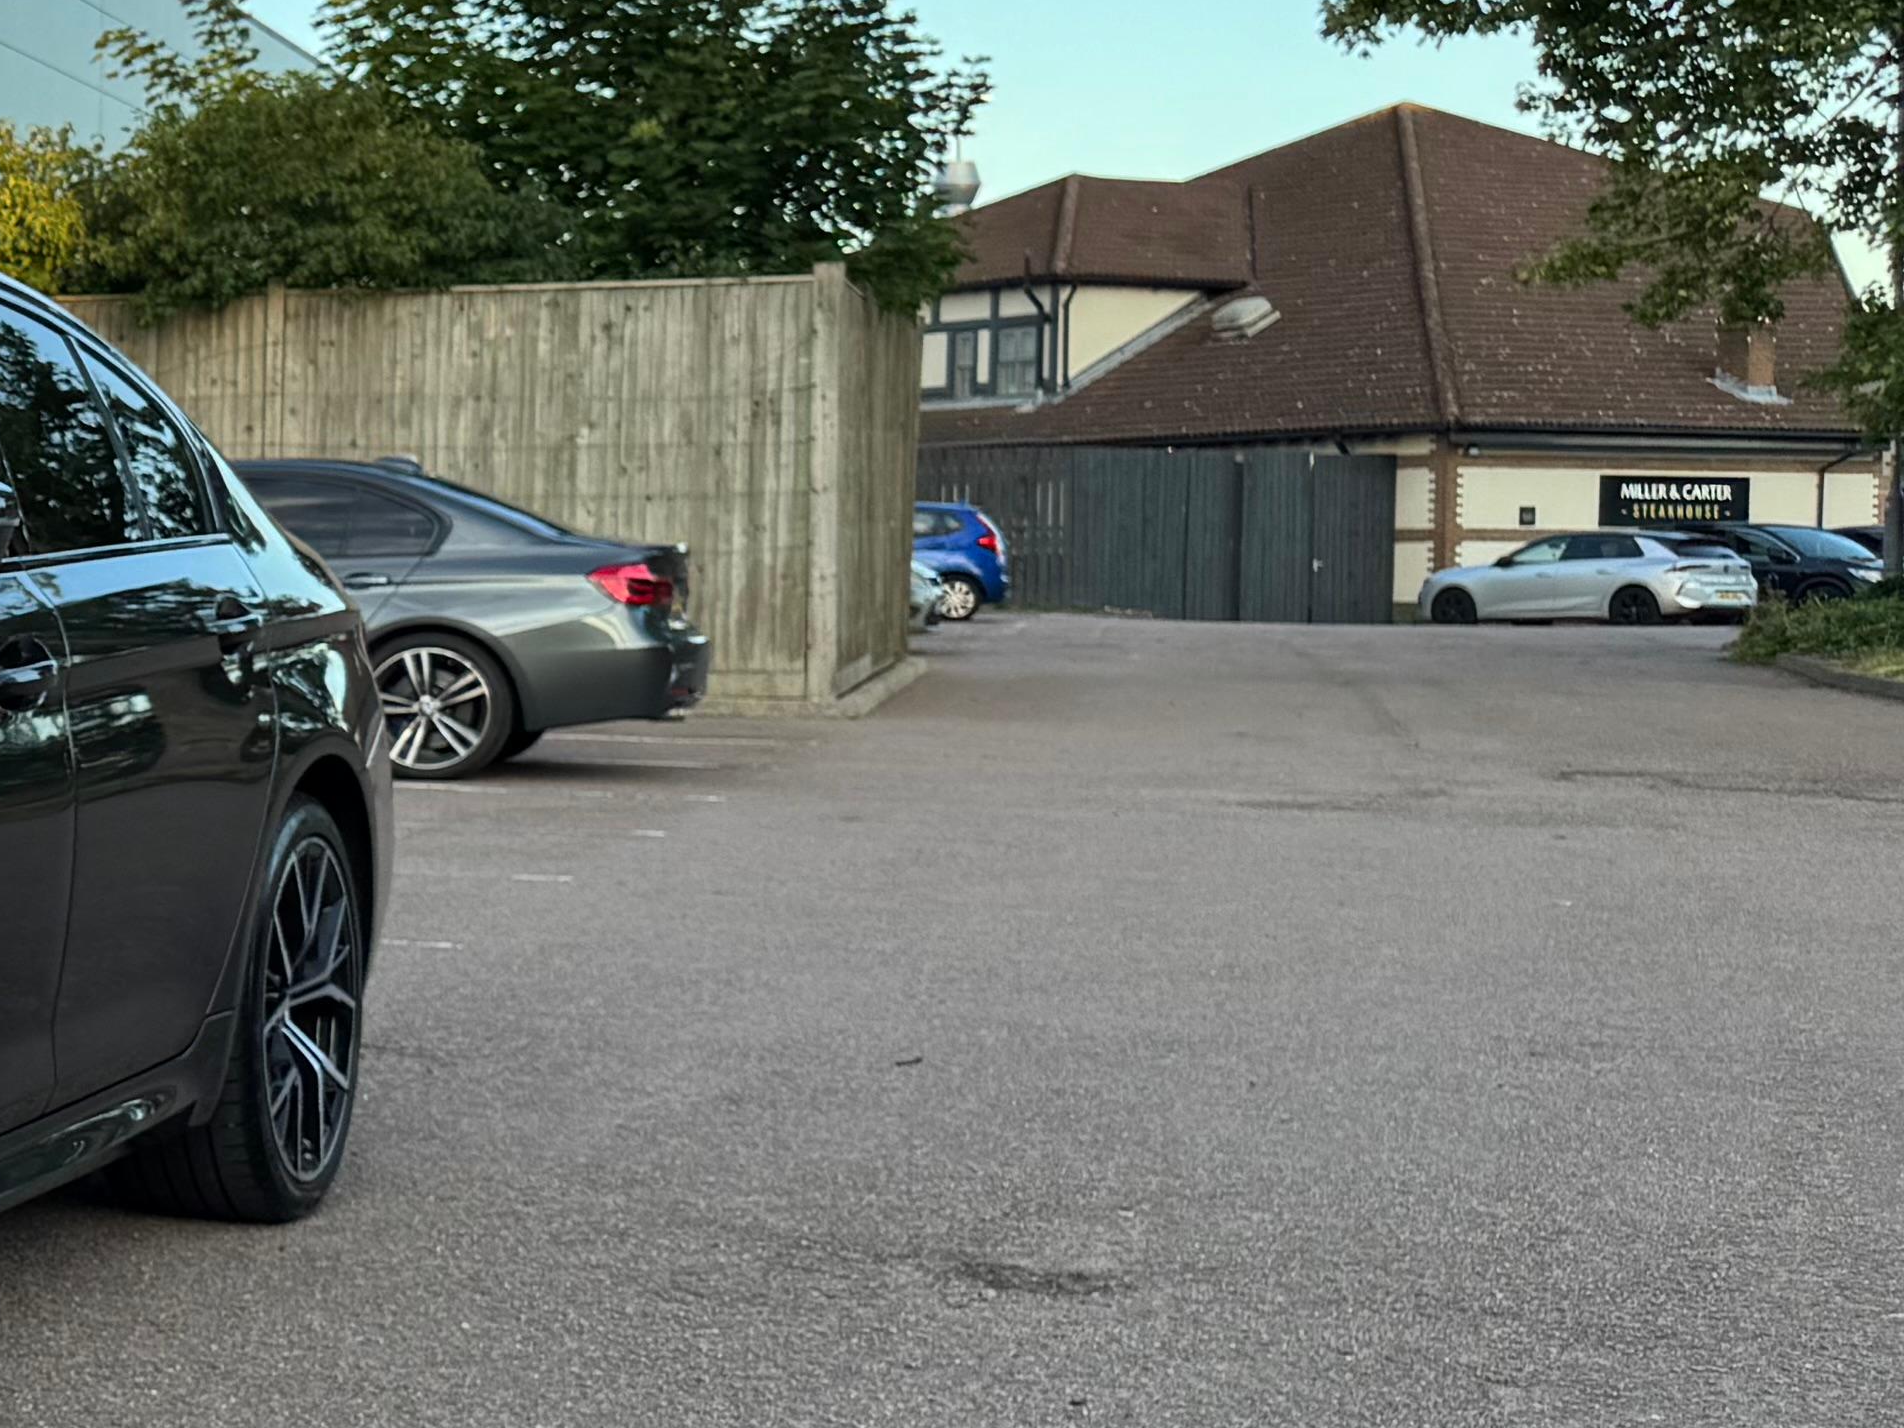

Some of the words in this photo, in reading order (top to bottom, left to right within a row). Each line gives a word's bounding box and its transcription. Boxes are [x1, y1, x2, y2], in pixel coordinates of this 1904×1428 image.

[1620, 483, 1667, 500] MILLER
[1669, 483, 1681, 500] &
[1682, 484, 1732, 501] CARTER
[1632, 503, 1720, 520] STEAKHOUSE
